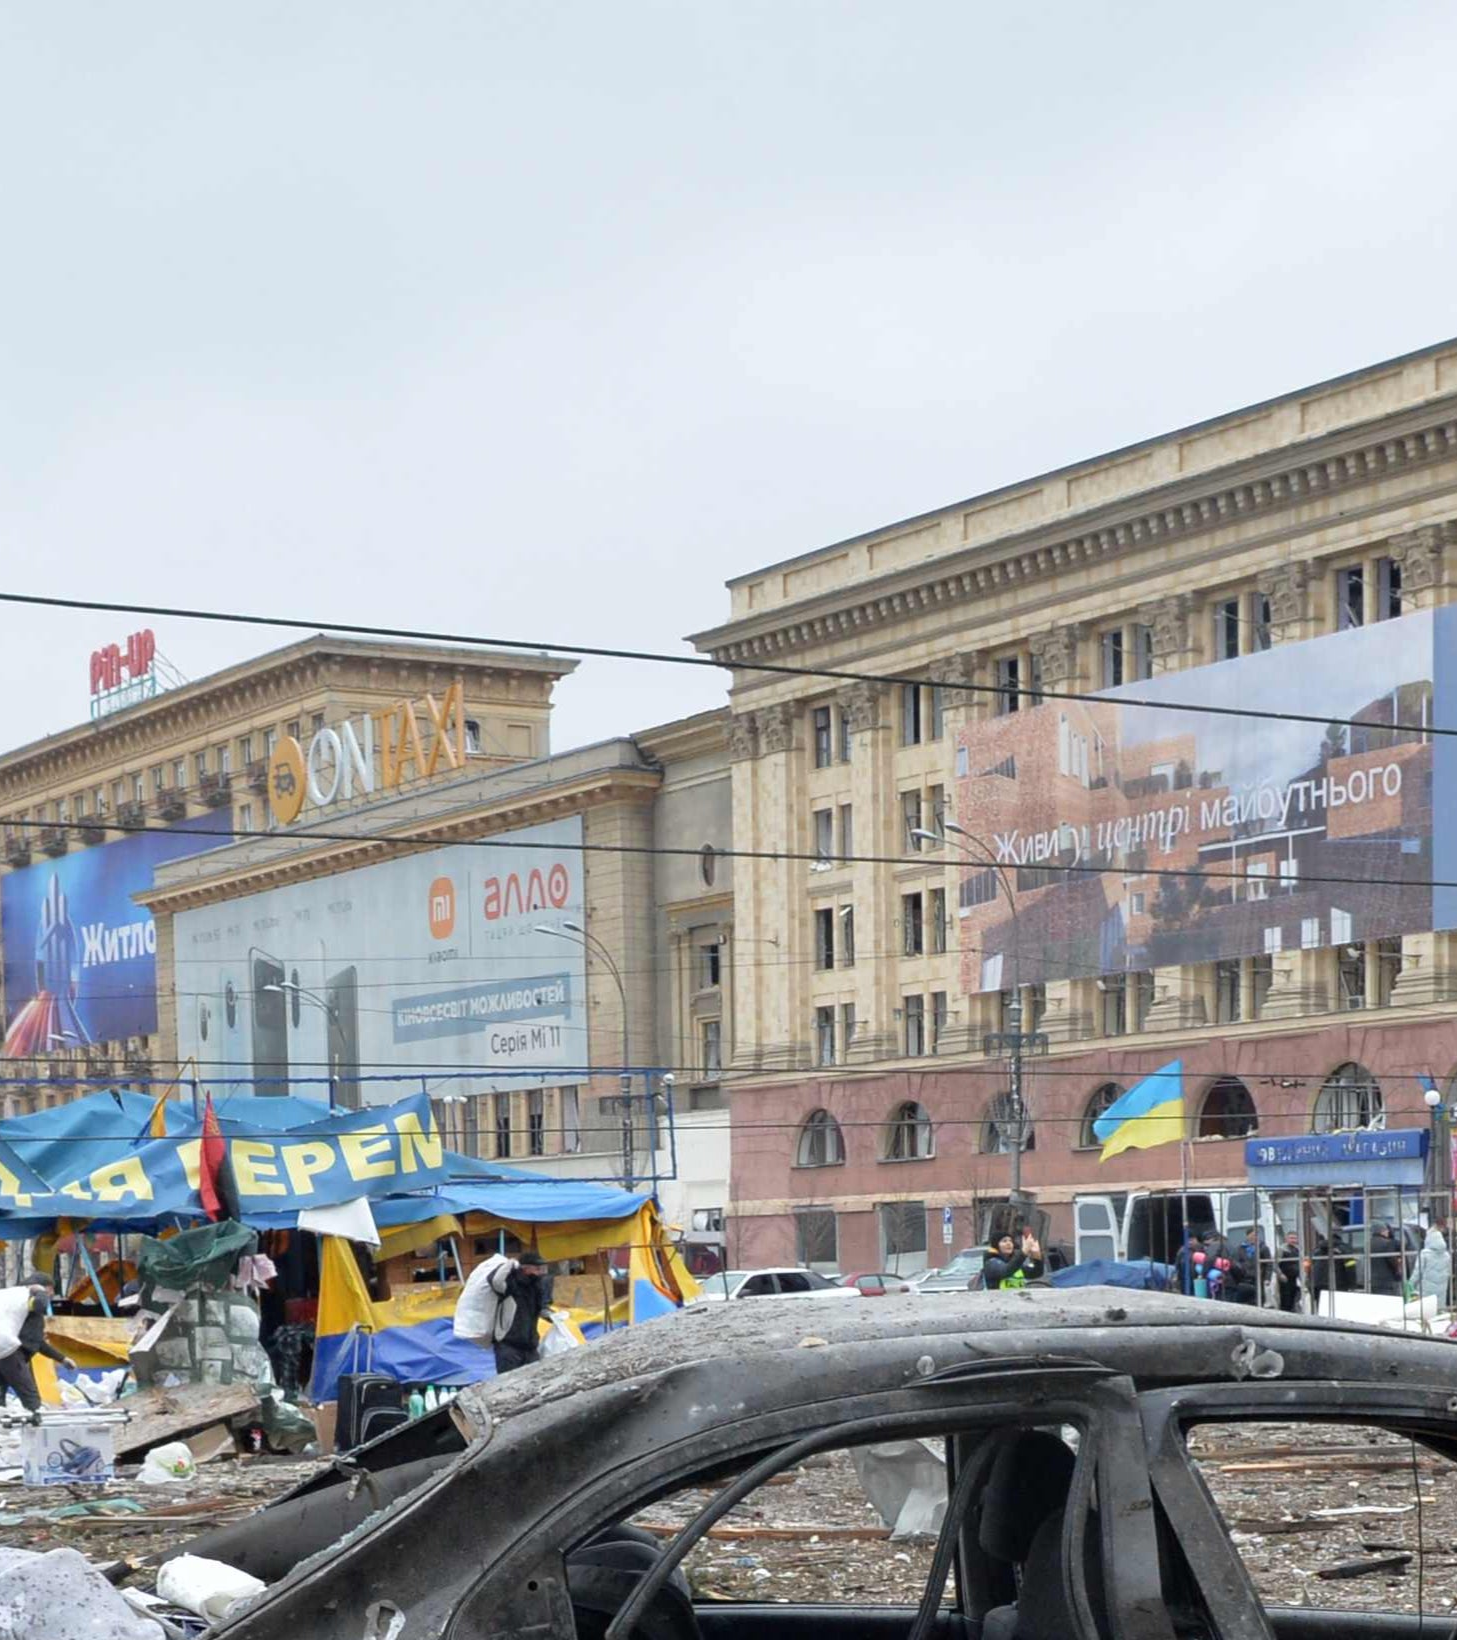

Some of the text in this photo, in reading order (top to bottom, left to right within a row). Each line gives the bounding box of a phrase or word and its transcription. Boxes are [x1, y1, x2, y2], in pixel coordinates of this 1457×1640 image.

[993, 828, 1059, 865] Живи
[1097, 791, 1192, 862] центрі
[1199, 763, 1403, 831] майбутнього
[491, 1029, 528, 1056] Серія
[549, 1026, 561, 1047] 11
